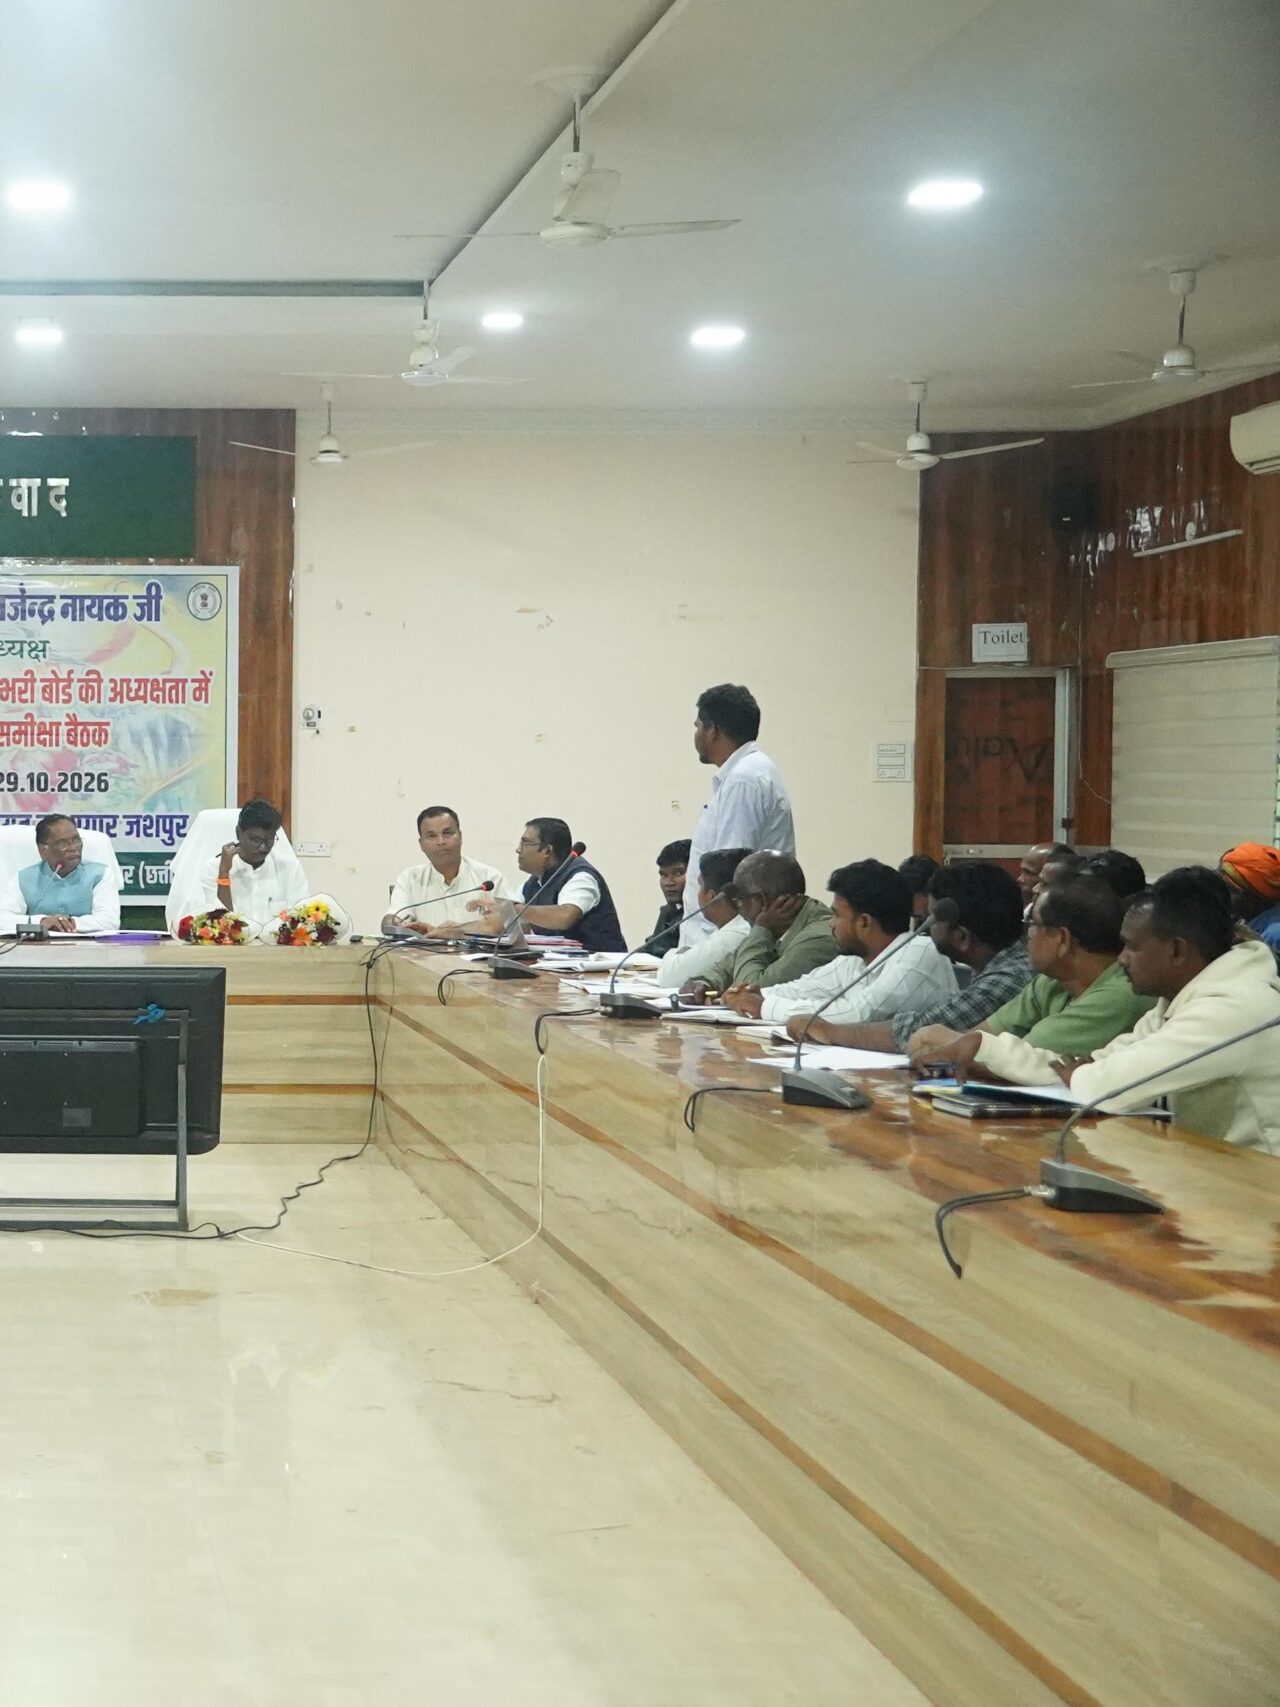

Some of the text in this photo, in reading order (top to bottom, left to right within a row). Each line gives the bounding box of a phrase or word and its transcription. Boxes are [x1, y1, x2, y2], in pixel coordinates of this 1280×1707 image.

[59, 594, 129, 622] नायक
[132, 581, 163, 622] जी
[979, 630, 1025, 645] Toilet
[40, 669, 74, 704] बोर्ड
[77, 669, 104, 704] की
[108, 677, 188, 705] अध्यक्षता
[190, 670, 214, 704] में
[64, 713, 111, 748] बैठक
[122, 814, 190, 847] जशपुर
